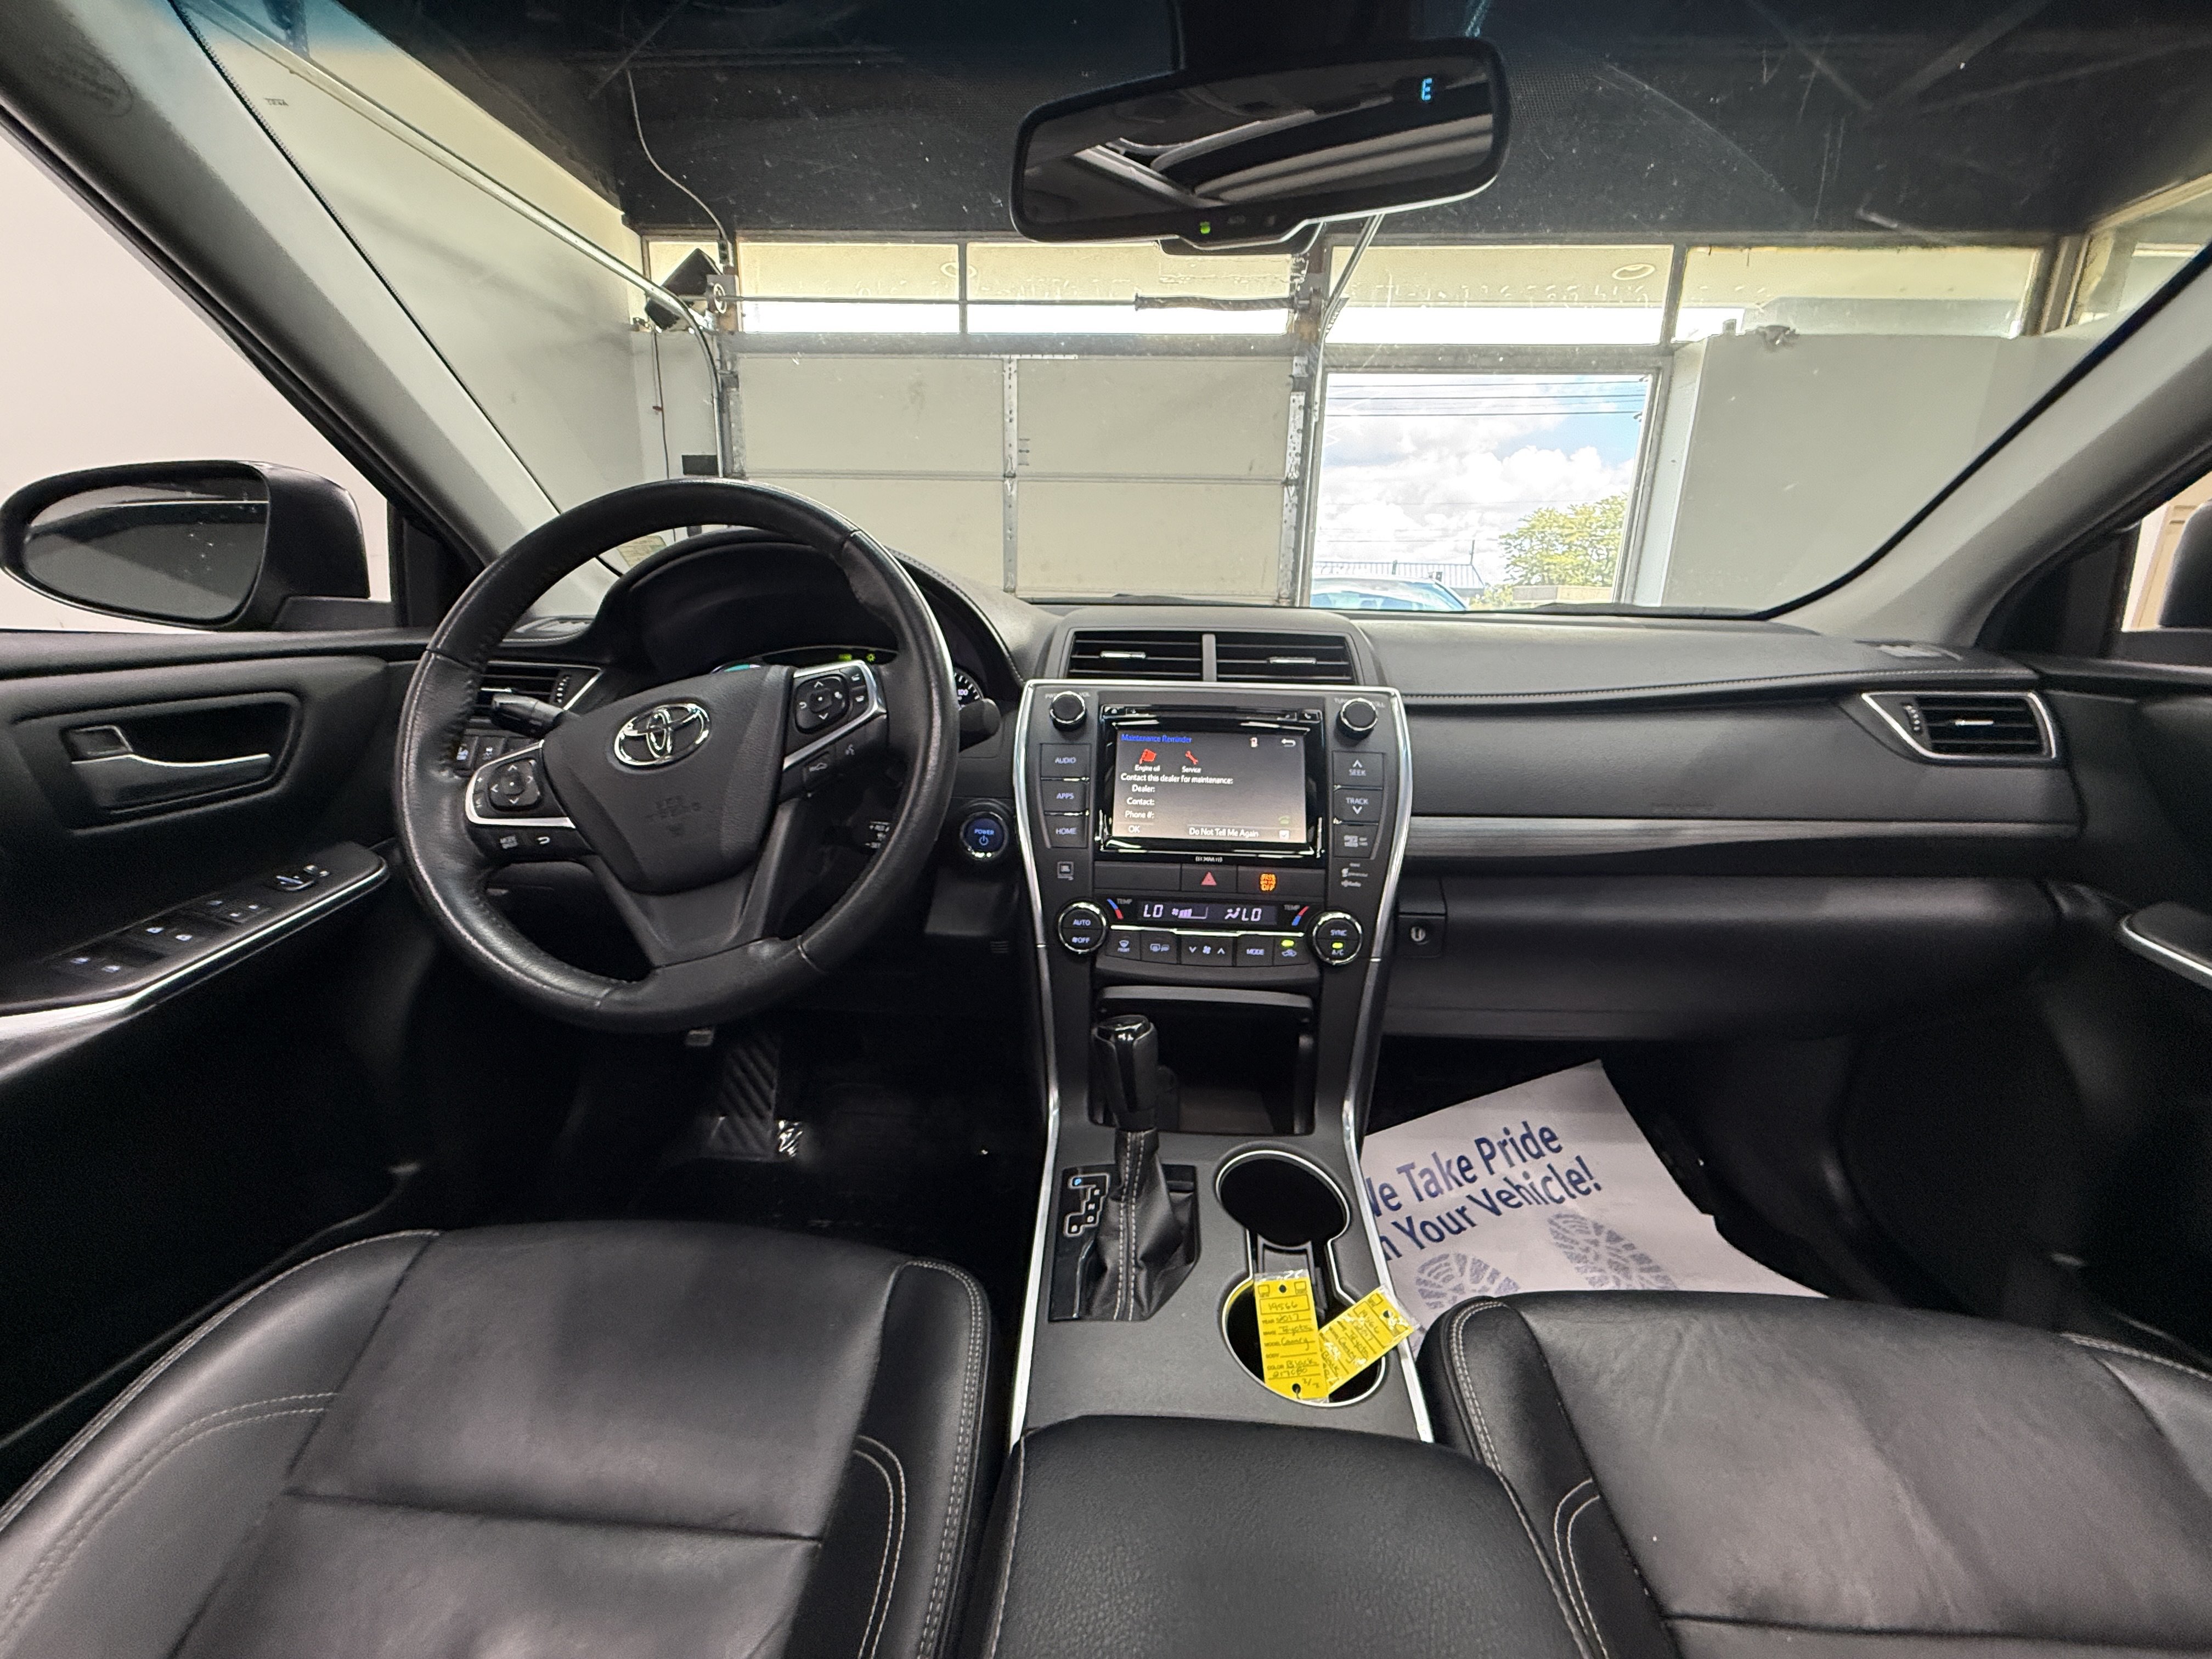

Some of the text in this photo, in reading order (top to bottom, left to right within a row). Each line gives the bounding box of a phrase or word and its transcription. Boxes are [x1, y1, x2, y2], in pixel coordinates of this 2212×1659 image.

[1421, 78, 1432, 101] E
[1121, 734, 1192, 743] Maintenance Reminder
[1121, 773, 1146, 781] Contact
[1191, 776, 1233, 785] maintenance:
[1127, 797, 1155, 805] Contact:
[1125, 810, 1146, 819] Phone
[1189, 827, 1259, 839] Do Not Tell Me Again
[1143, 904, 1164, 917] LO
[1242, 907, 1262, 922] LO
[1396, 1152, 1477, 1201] Take
[1475, 1120, 1562, 1175] Pride
[1391, 1206, 1477, 1250] Your
[1466, 1155, 1601, 1216] Vehicle!
